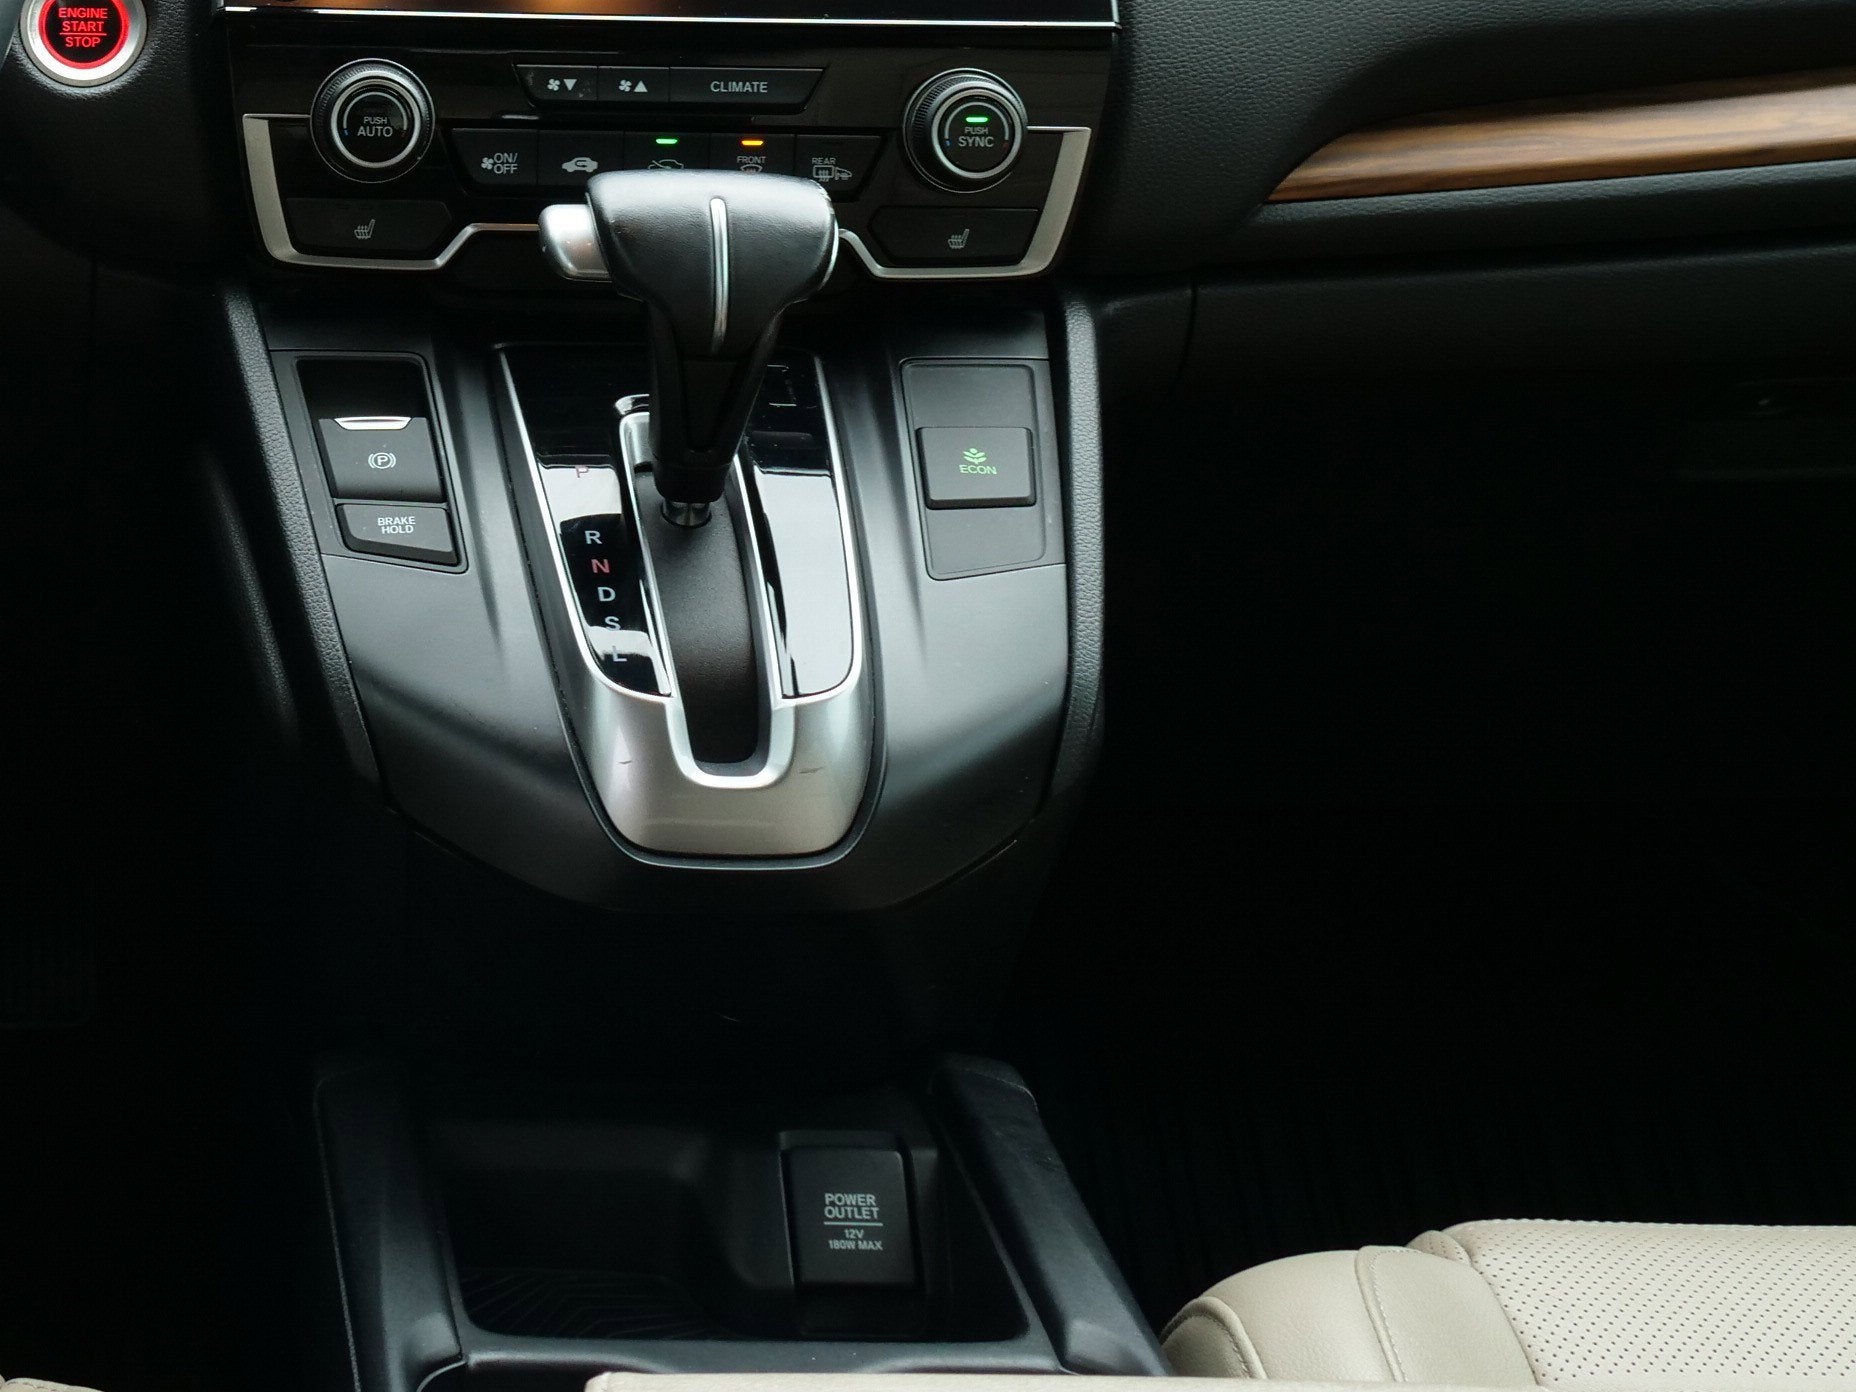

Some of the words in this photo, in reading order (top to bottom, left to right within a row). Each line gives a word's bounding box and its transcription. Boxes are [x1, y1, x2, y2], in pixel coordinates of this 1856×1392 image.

[58, 7, 109, 19] ENGINE
[62, 20, 105, 32] START
[65, 36, 101, 48] STOP
[710, 80, 769, 93] CLIMATE
[363, 116, 388, 125] PUSH
[357, 126, 393, 138] AUTO
[964, 126, 989, 135] PUSH
[958, 136, 994, 148] SYNC
[493, 152, 519, 164] ON/
[736, 155, 767, 164] FRONT
[811, 157, 837, 165] REAR
[493, 163, 518, 175] OFF
[958, 464, 998, 475] ECON
[377, 516, 416, 526] BRAKE
[381, 524, 414, 535] HOLD
[584, 530, 603, 545] R
[591, 559, 611, 574] N
[597, 586, 616, 602] D
[604, 616, 621, 631] S
[824, 1192, 877, 1206] POWER
[824, 1205, 880, 1220] OUTLET
[844, 1228, 865, 1239] 12V
[858, 1240, 884, 1251] MAX
